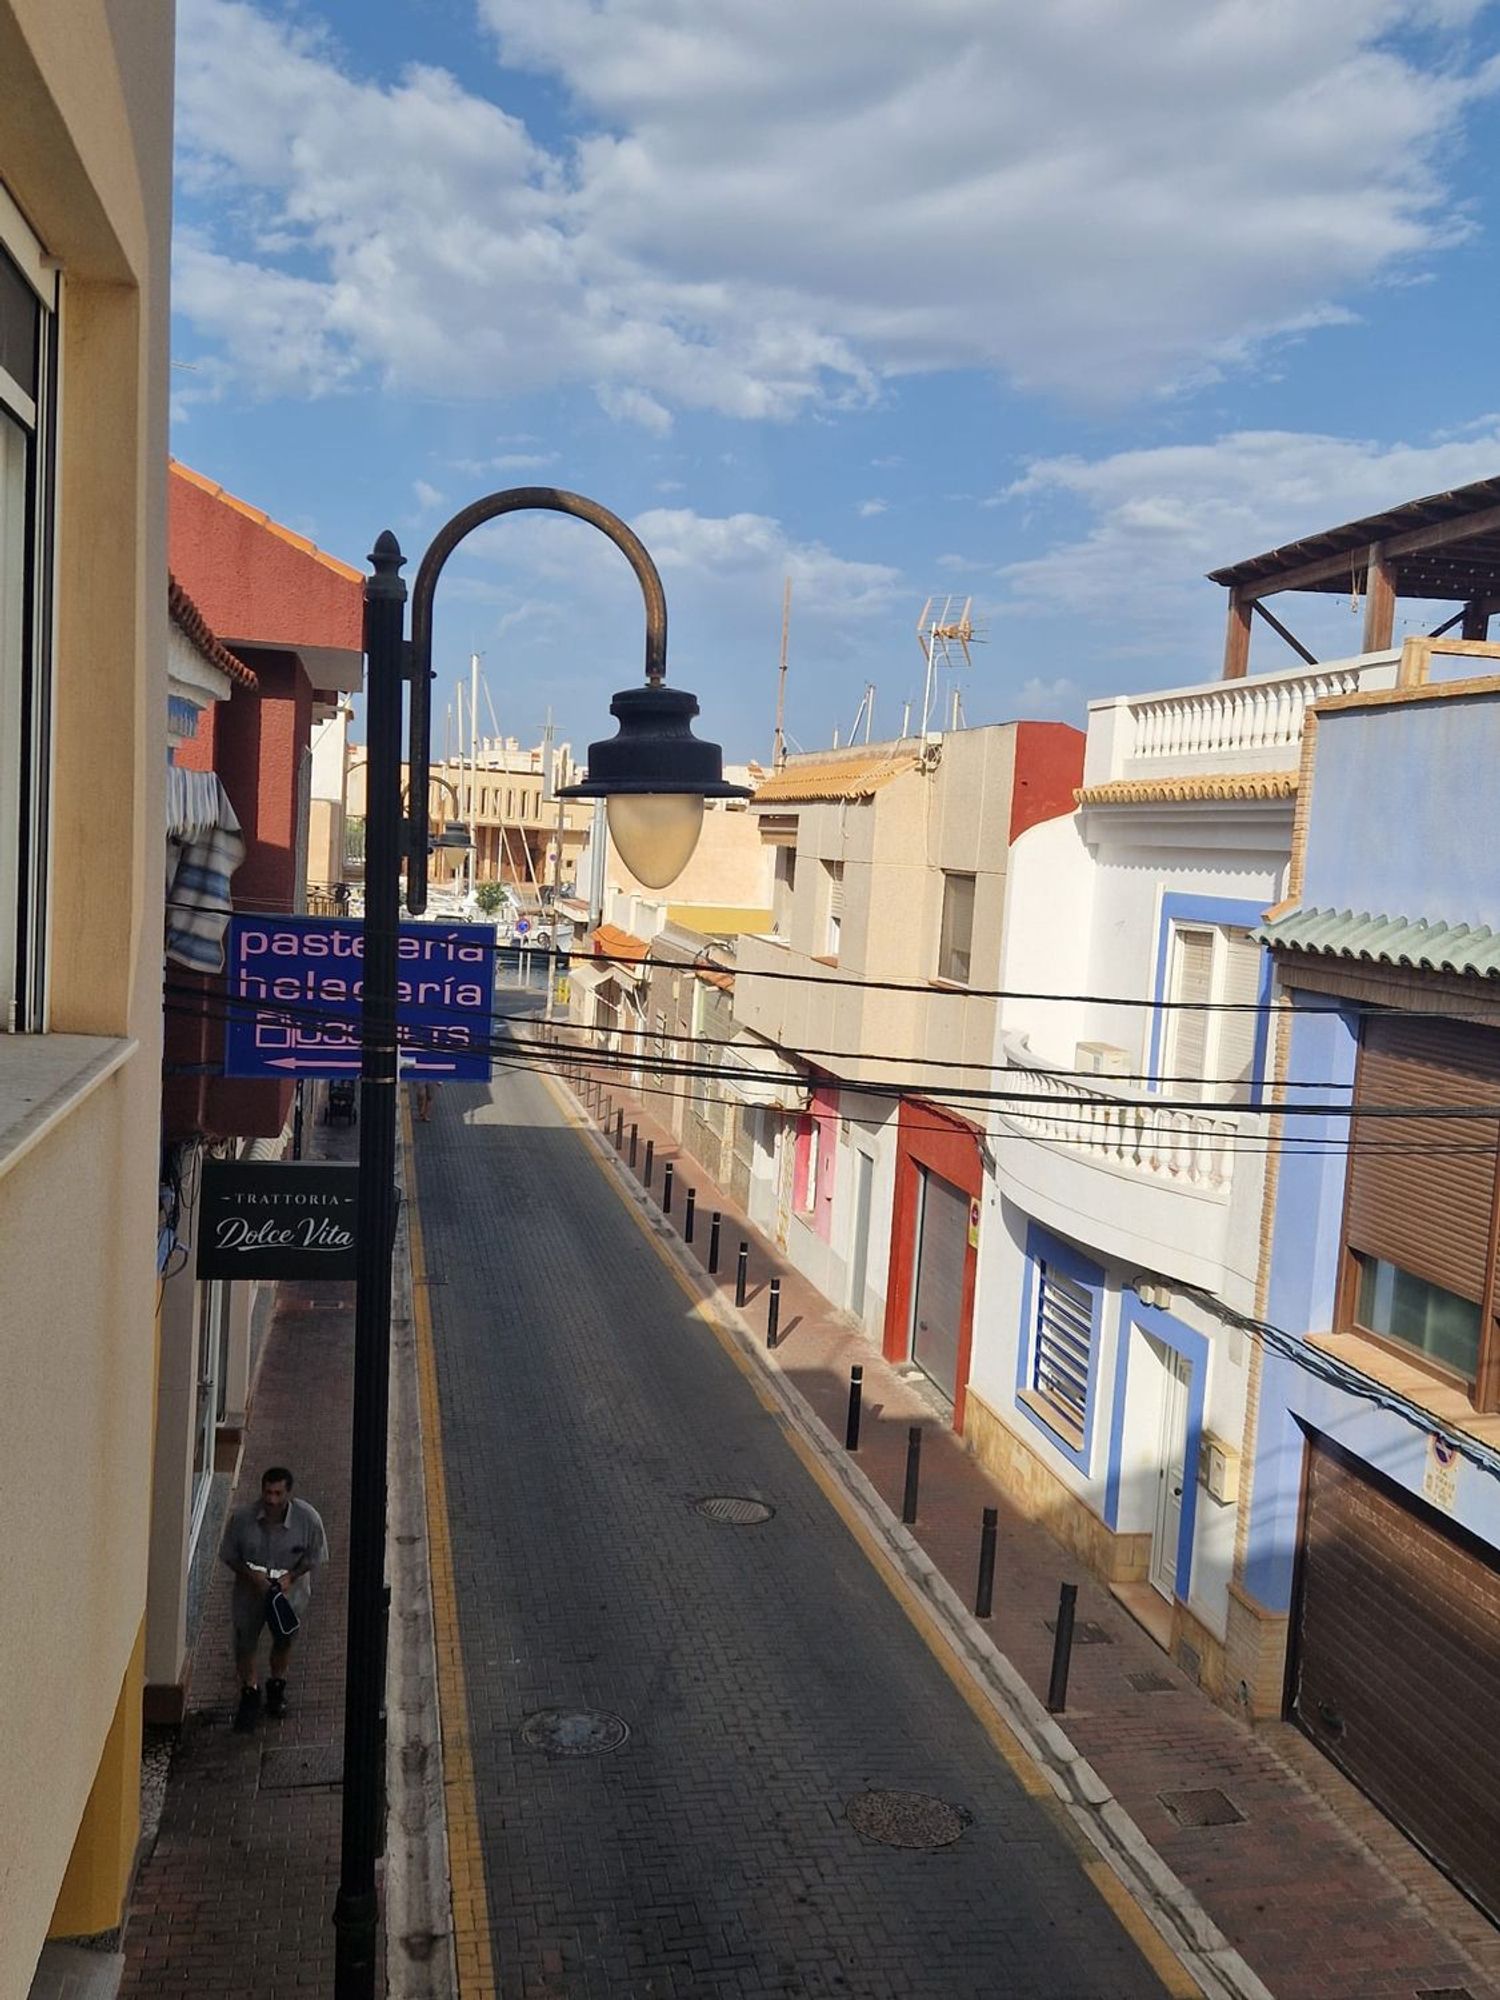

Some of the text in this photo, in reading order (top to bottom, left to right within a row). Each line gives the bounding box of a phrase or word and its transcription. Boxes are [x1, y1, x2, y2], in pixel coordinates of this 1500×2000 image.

[239, 930, 484, 962] pasteería
[234, 1192, 340, 1205] TRATTORIA
[215, 1217, 354, 1249] Dolce Vita
